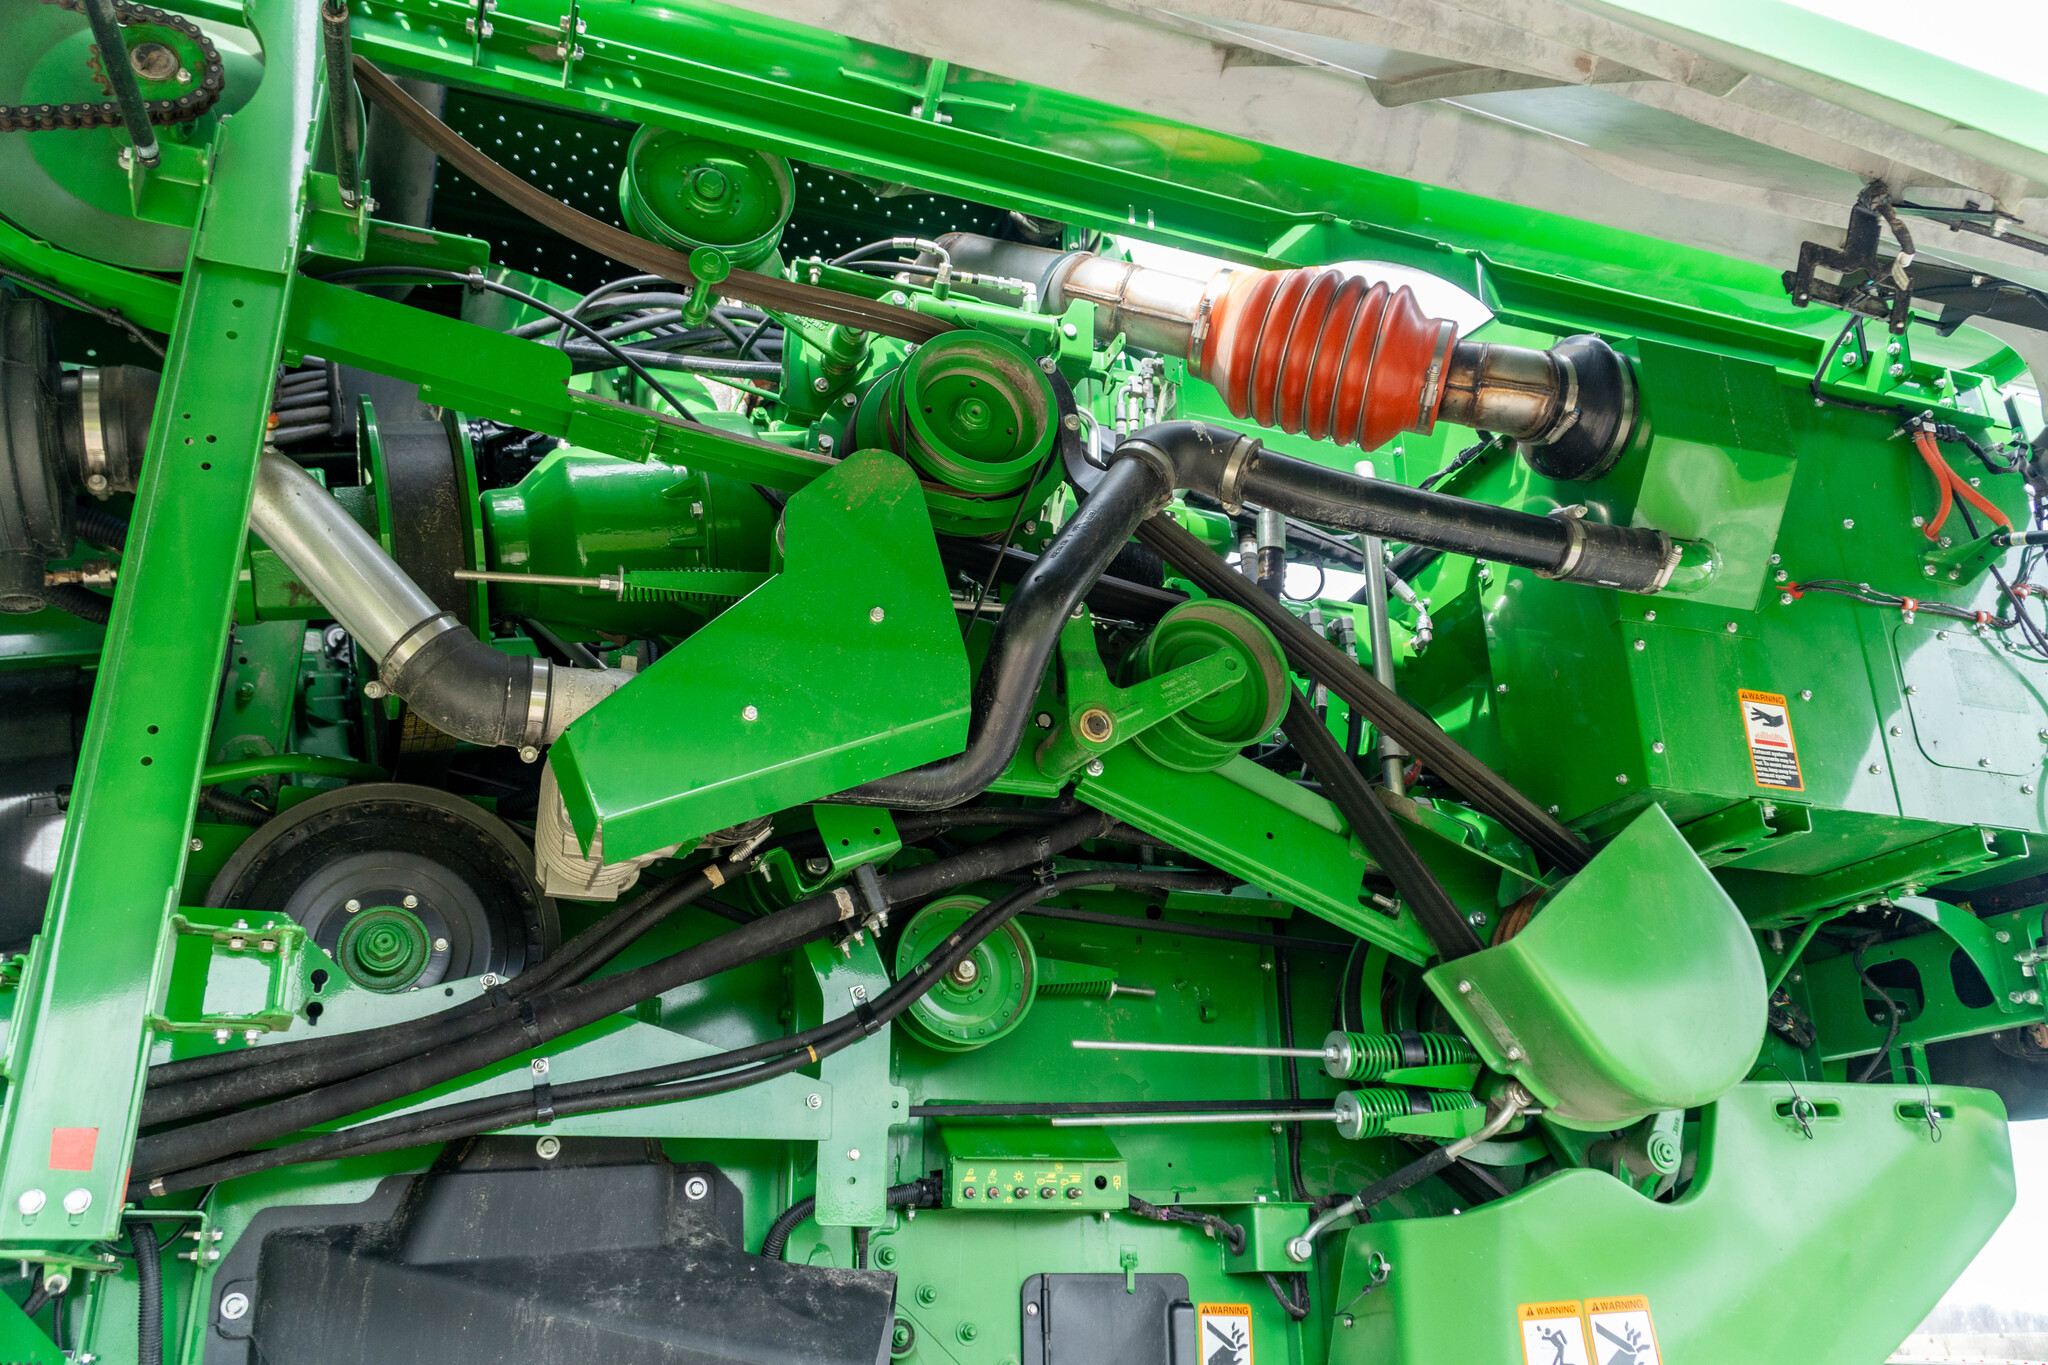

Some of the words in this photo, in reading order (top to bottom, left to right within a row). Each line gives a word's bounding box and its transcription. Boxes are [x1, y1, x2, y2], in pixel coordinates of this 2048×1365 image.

[1748, 692, 1785, 704] WARNING
[1210, 1306, 1248, 1315] WARNING
[1536, 1305, 1576, 1316] WARNING
[1600, 1300, 1644, 1311] WARNING
